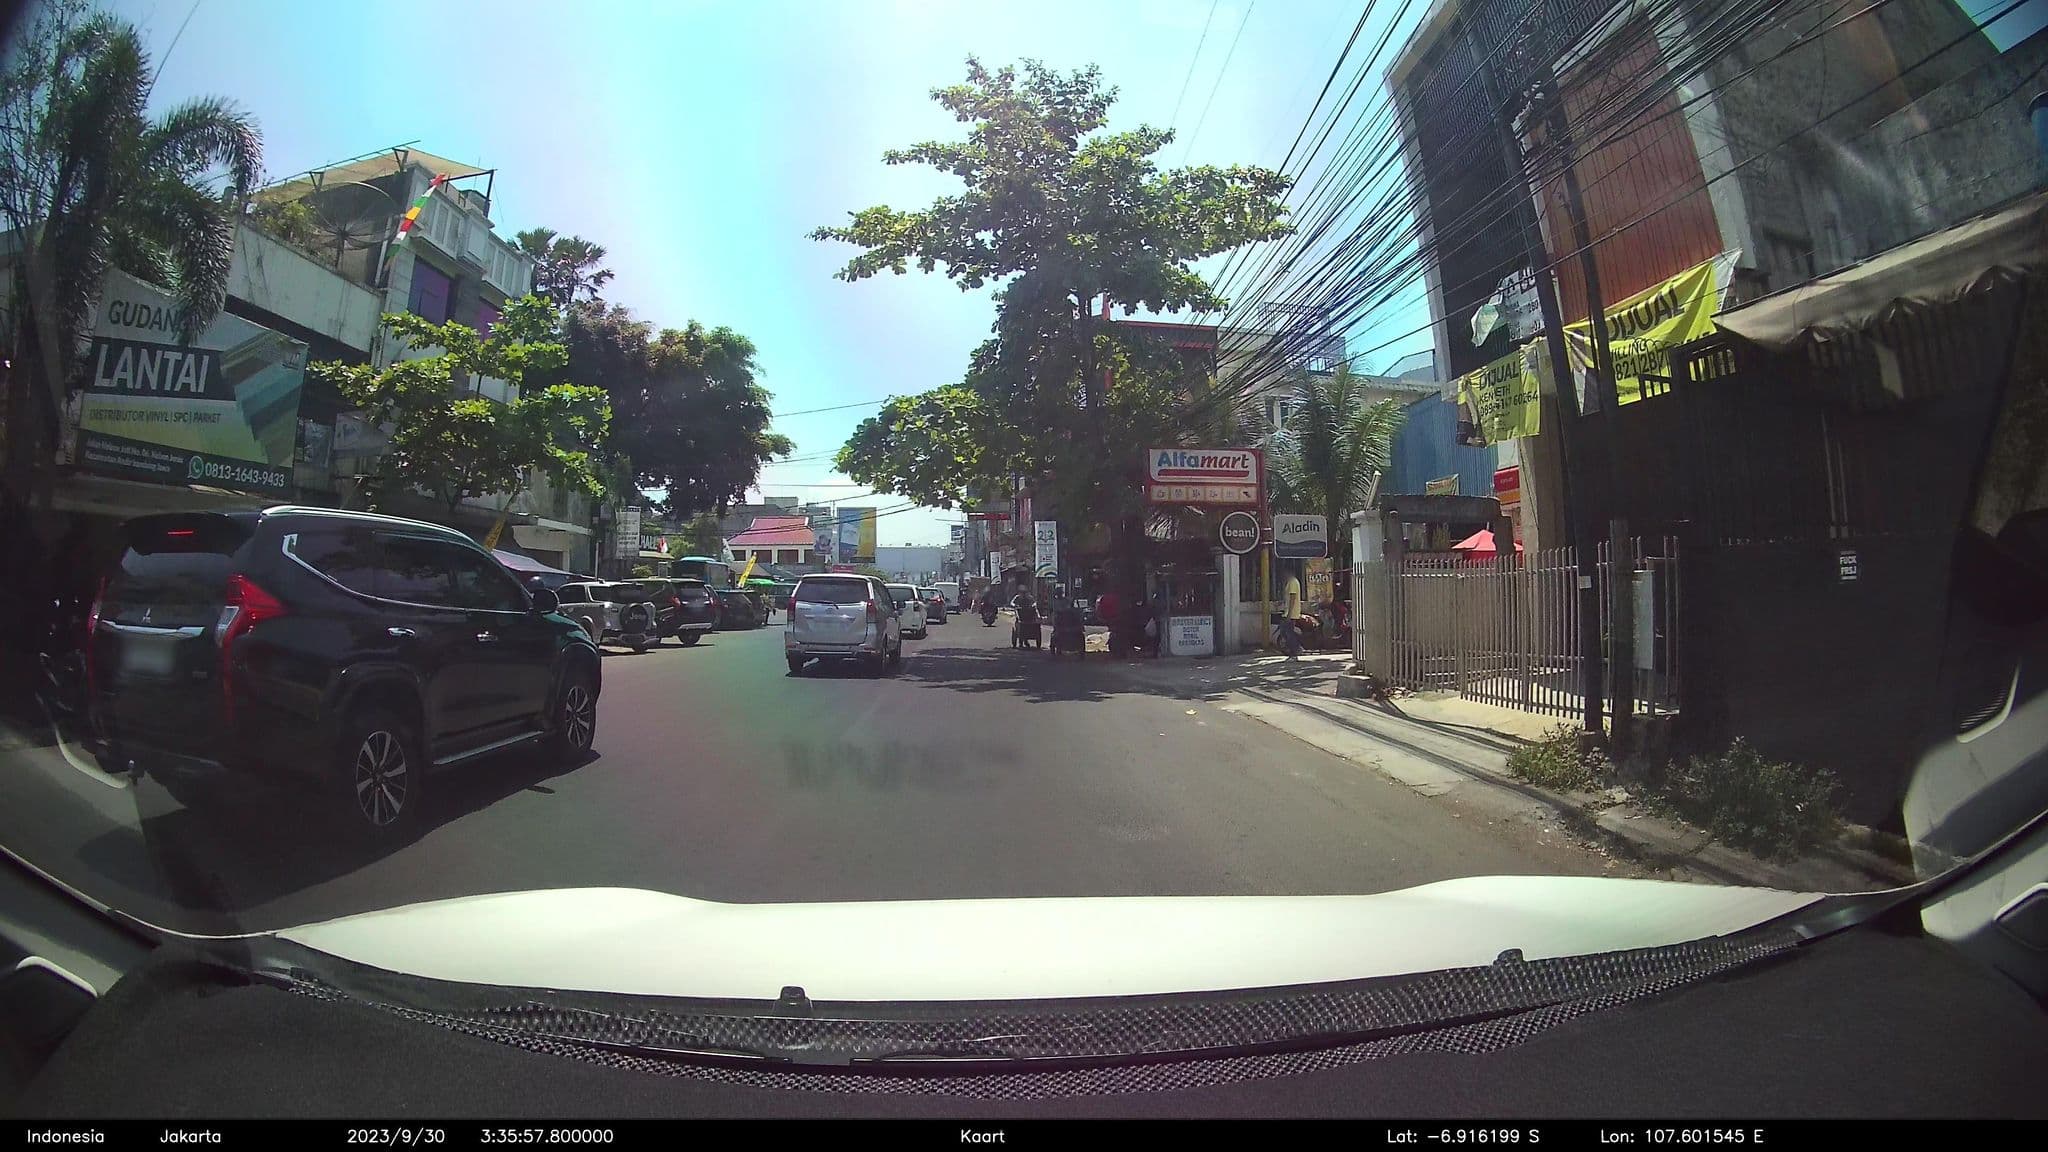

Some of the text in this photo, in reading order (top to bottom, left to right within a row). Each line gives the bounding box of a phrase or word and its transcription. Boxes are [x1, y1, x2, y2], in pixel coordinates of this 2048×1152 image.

[94, 344, 210, 393] LANTAI
[88, 408, 145, 422] DISTRIBUTOR
[145, 410, 169, 422] VINYL
[1157, 451, 1249, 469] Alfamart
[205, 462, 285, 488] 0813-1643-9433
[1225, 526, 1255, 538] bean!
[1282, 520, 1320, 534] Aladin
[1839, 556, 1857, 565] FUCK
